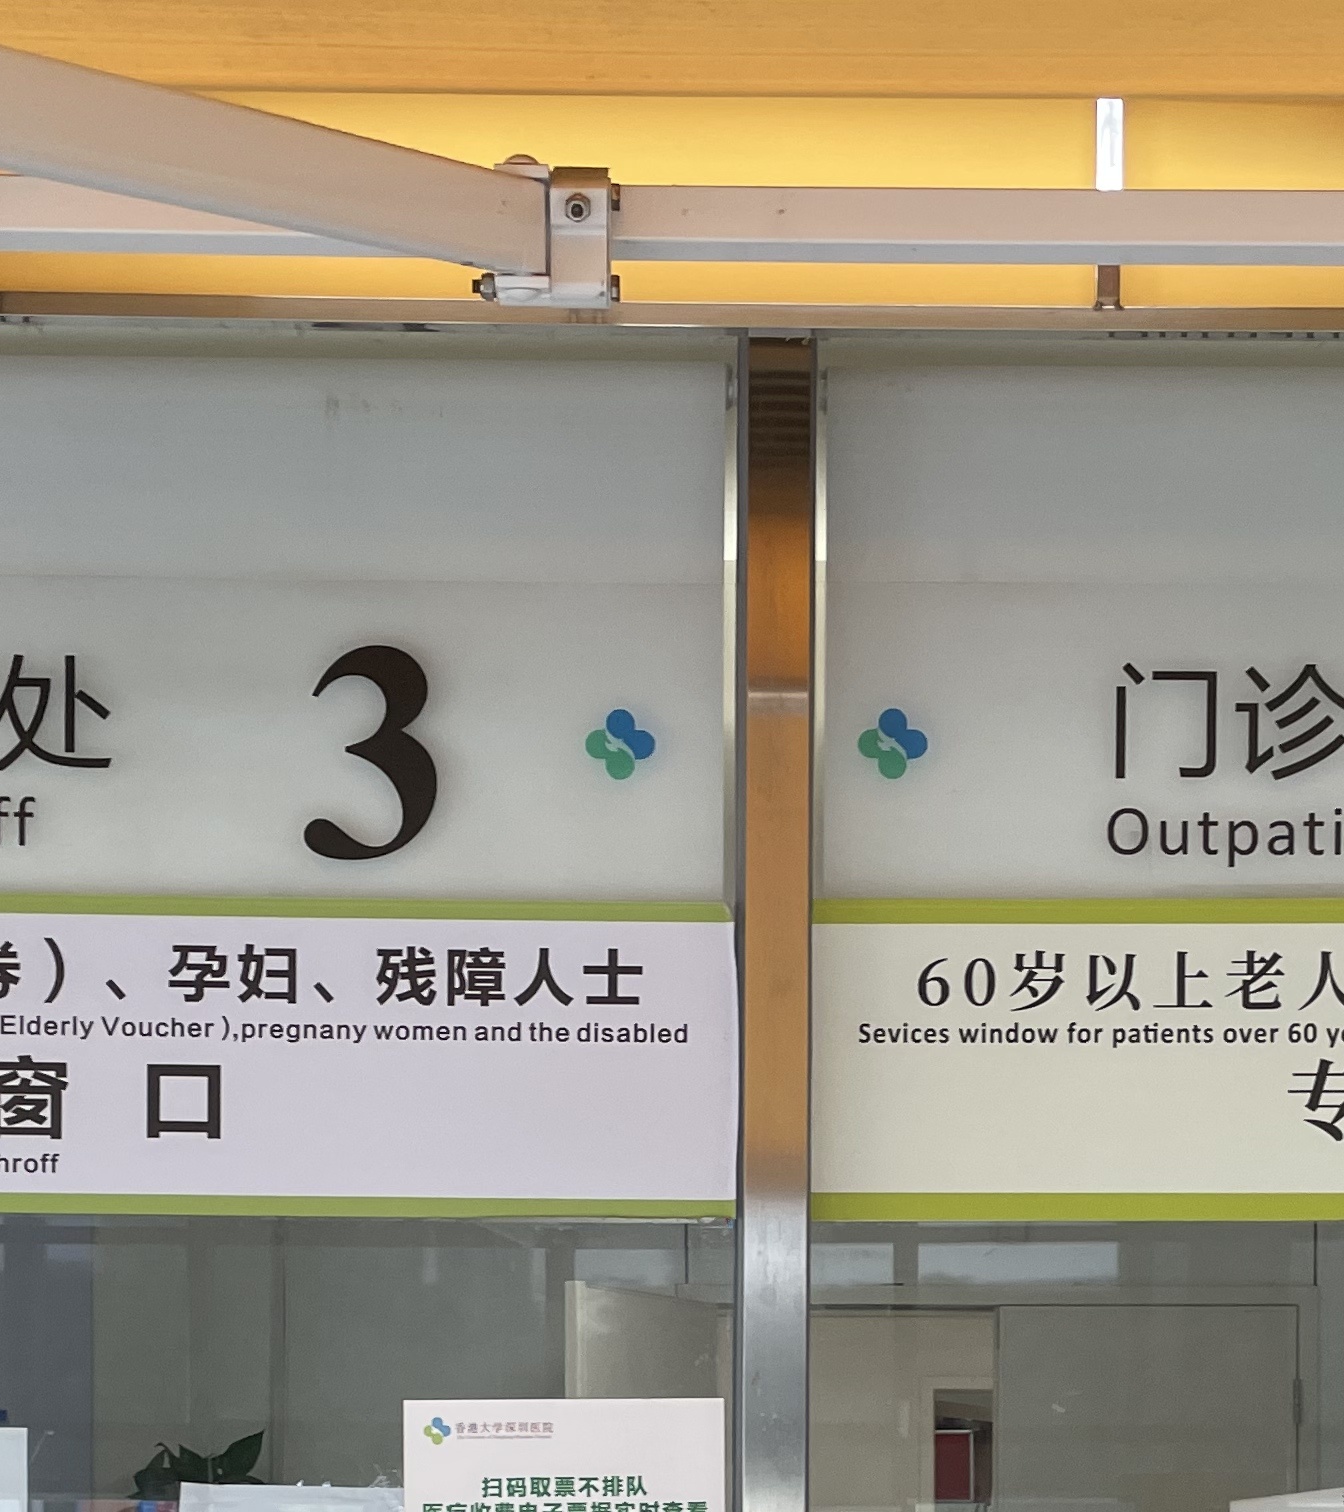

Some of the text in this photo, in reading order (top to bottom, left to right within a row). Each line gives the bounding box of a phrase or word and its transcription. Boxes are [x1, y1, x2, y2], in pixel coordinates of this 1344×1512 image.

[304, 645, 437, 860] 3
[1, 1015, 93, 1040] Elderly
[374, 1025, 466, 1041] women
[475, 1022, 521, 1042] and
[529, 1022, 569, 1042] the
[577, 1023, 687, 1044] disabled
[859, 1023, 949, 1043] Sevices
[959, 1022, 1058, 1043] window
[1067, 1022, 1102, 1043] for
[1113, 1023, 1213, 1048] patients
[1224, 1028, 1278, 1043] over
[1289, 1023, 1317, 1043] 60
[482, 1475, 647, 1498] 扫码取票不排队
